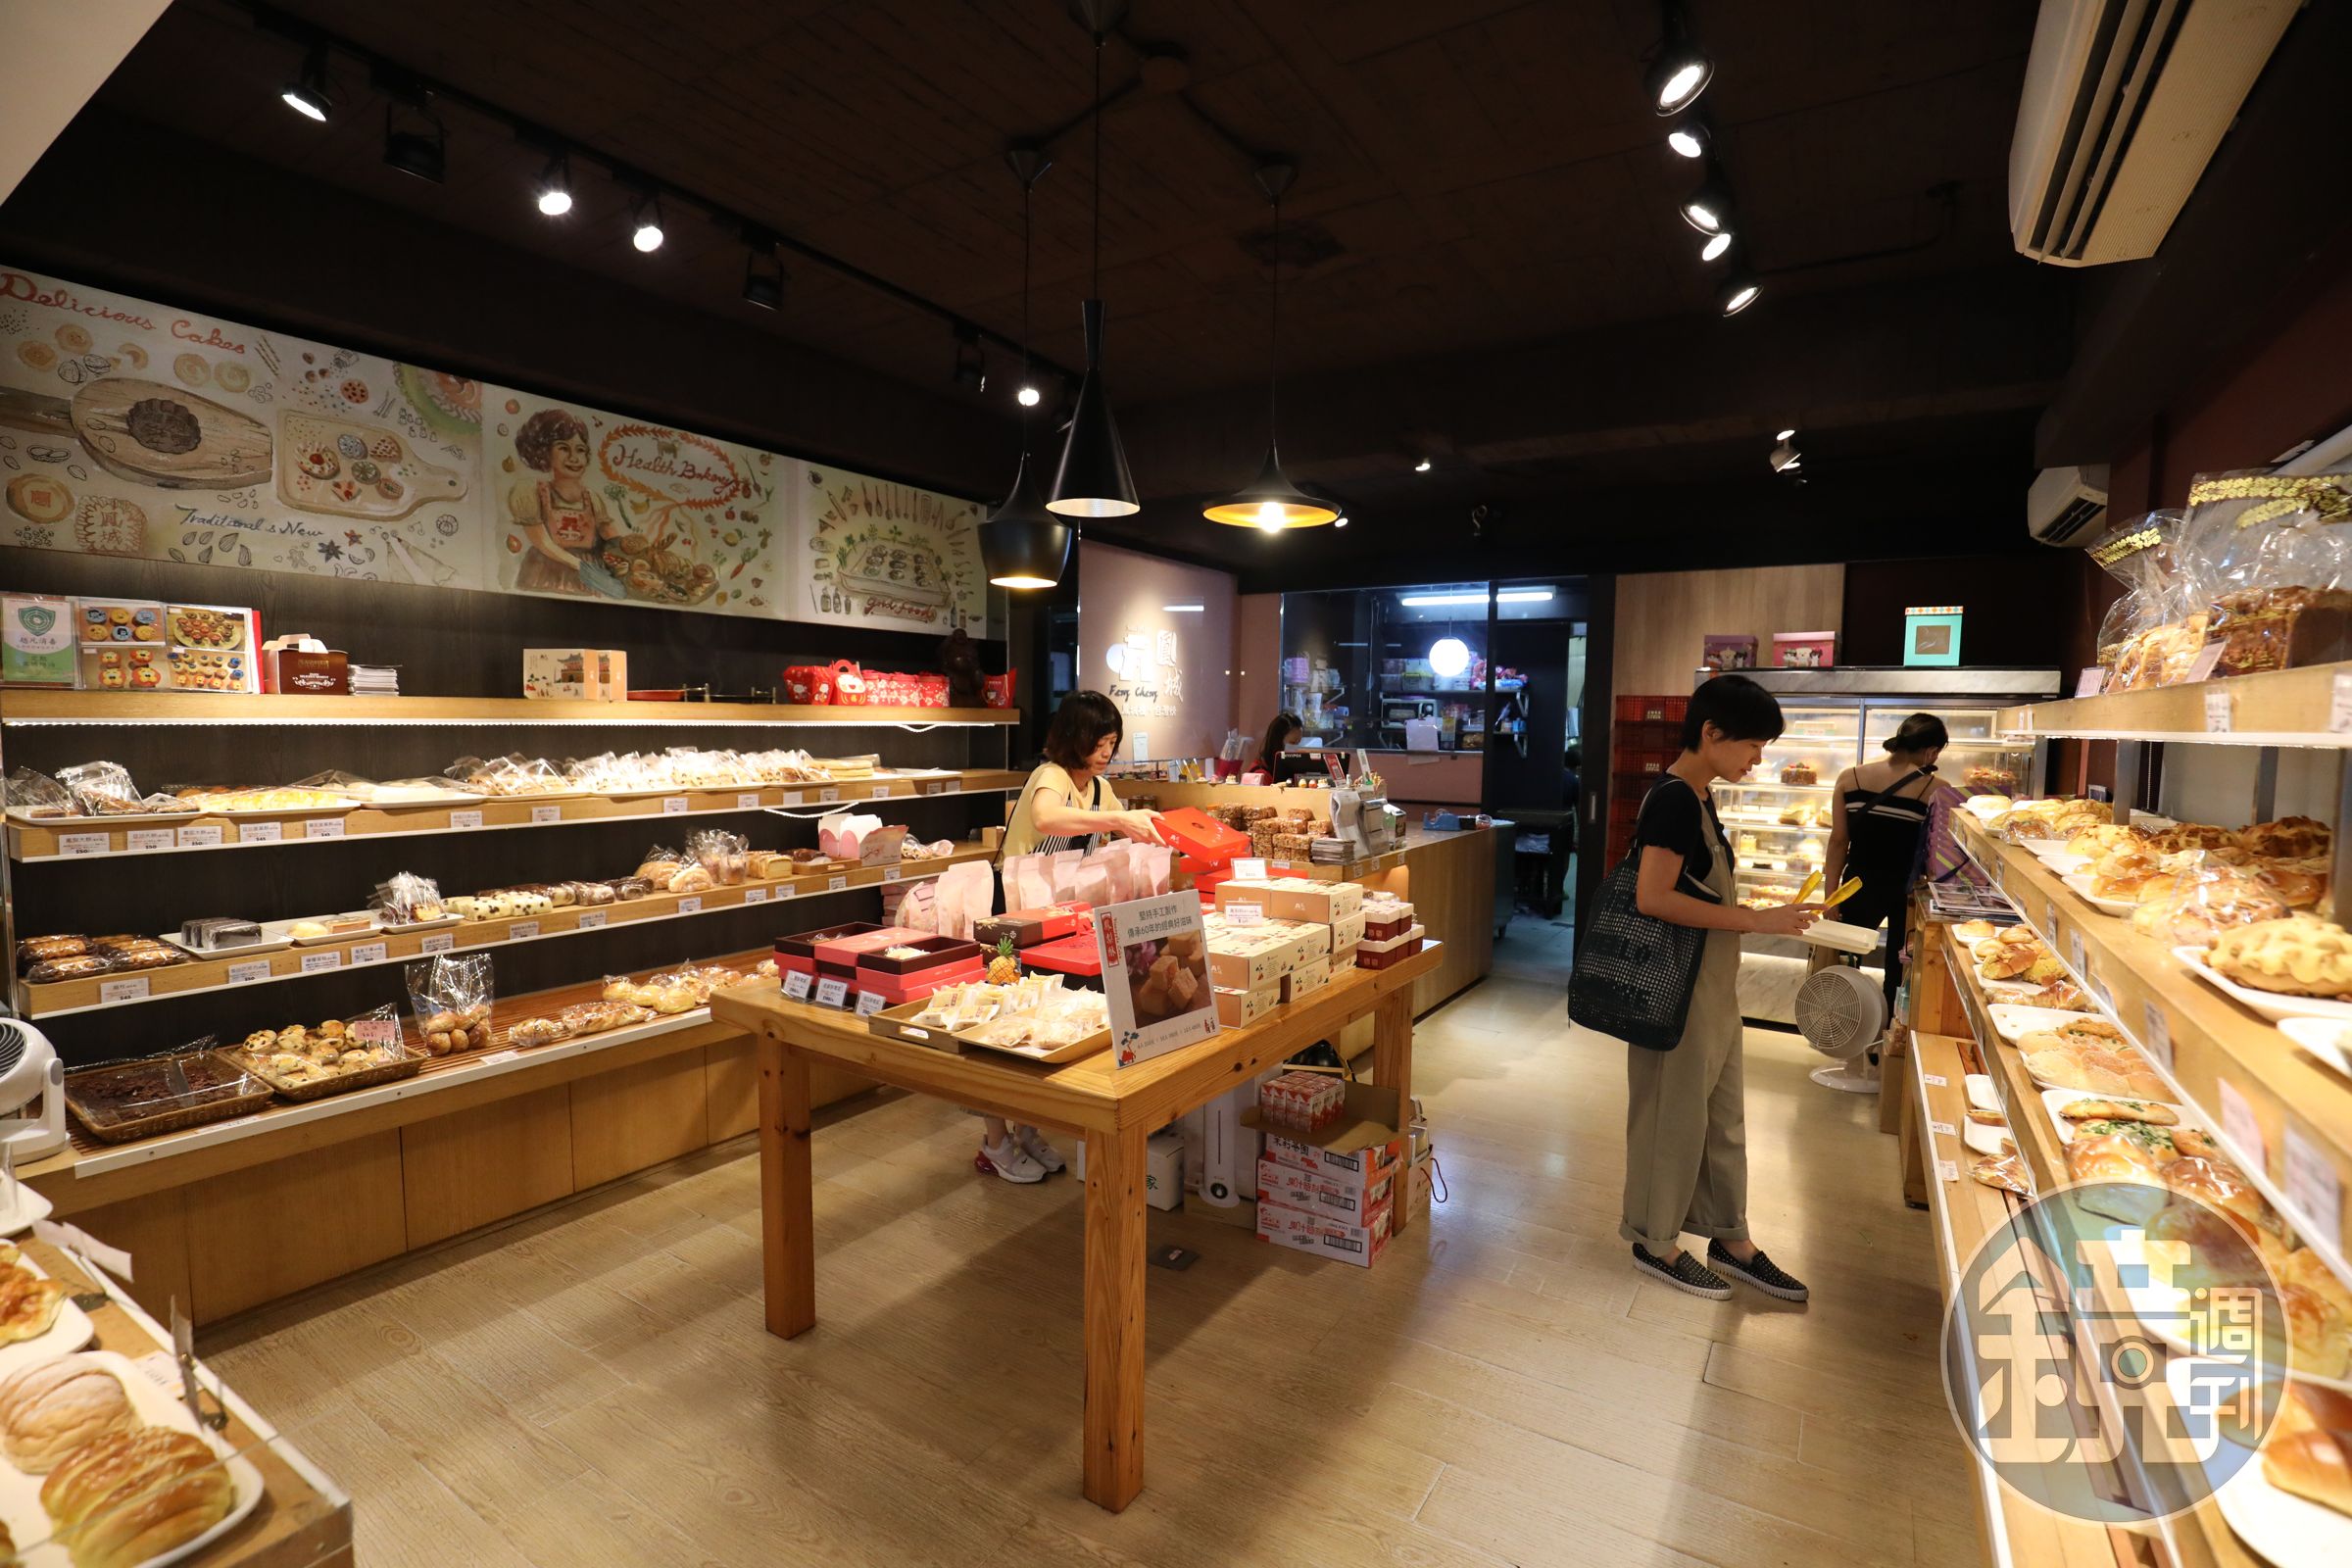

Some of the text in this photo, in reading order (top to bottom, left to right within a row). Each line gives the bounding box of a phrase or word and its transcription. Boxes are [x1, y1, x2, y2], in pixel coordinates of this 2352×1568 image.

[0, 272, 245, 355] Delicious Cakes
[612, 444, 678, 476] Health
[174, 503, 266, 531] Traditional
[279, 520, 324, 535] New
[1108, 684, 1159, 703] Feng Cheng
[1139, 905, 1177, 921] 堅持手工製作
